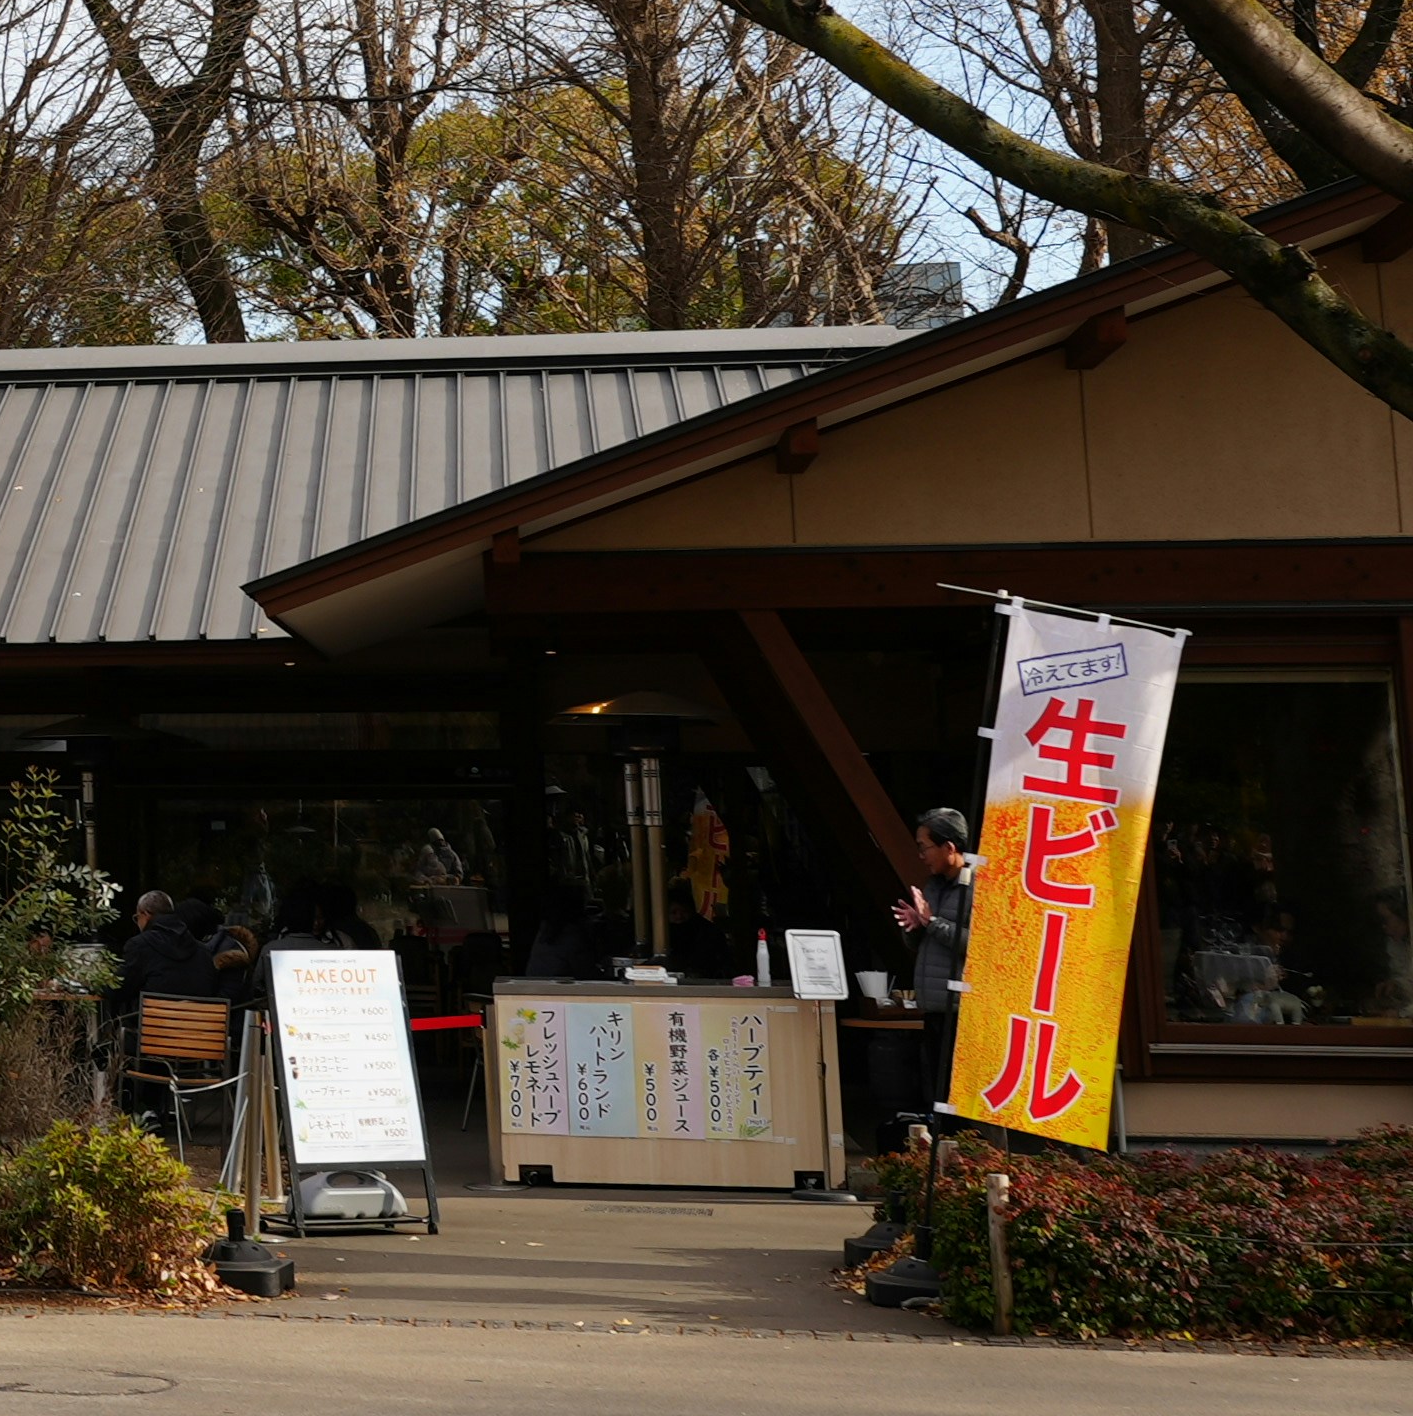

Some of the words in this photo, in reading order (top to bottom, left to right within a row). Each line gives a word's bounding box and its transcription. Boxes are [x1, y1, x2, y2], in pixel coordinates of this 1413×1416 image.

[1024, 654, 1121, 687] 冷えてます!
[981, 696, 1127, 1123] 生ビール
[541, 1010, 562, 1125] フレッシュハーブ
[589, 1026, 611, 1118] ハートランド
[607, 1011, 625, 1061] キリン
[668, 1011, 690, 1132] 有機野菜ジュース
[740, 1015, 765, 1115] ハーブティー
[509, 1060, 522, 1118] ¥700
[524, 1044, 543, 1127] レモネード
[577, 1063, 590, 1121] ¥600
[644, 1063, 657, 1121] ¥500
